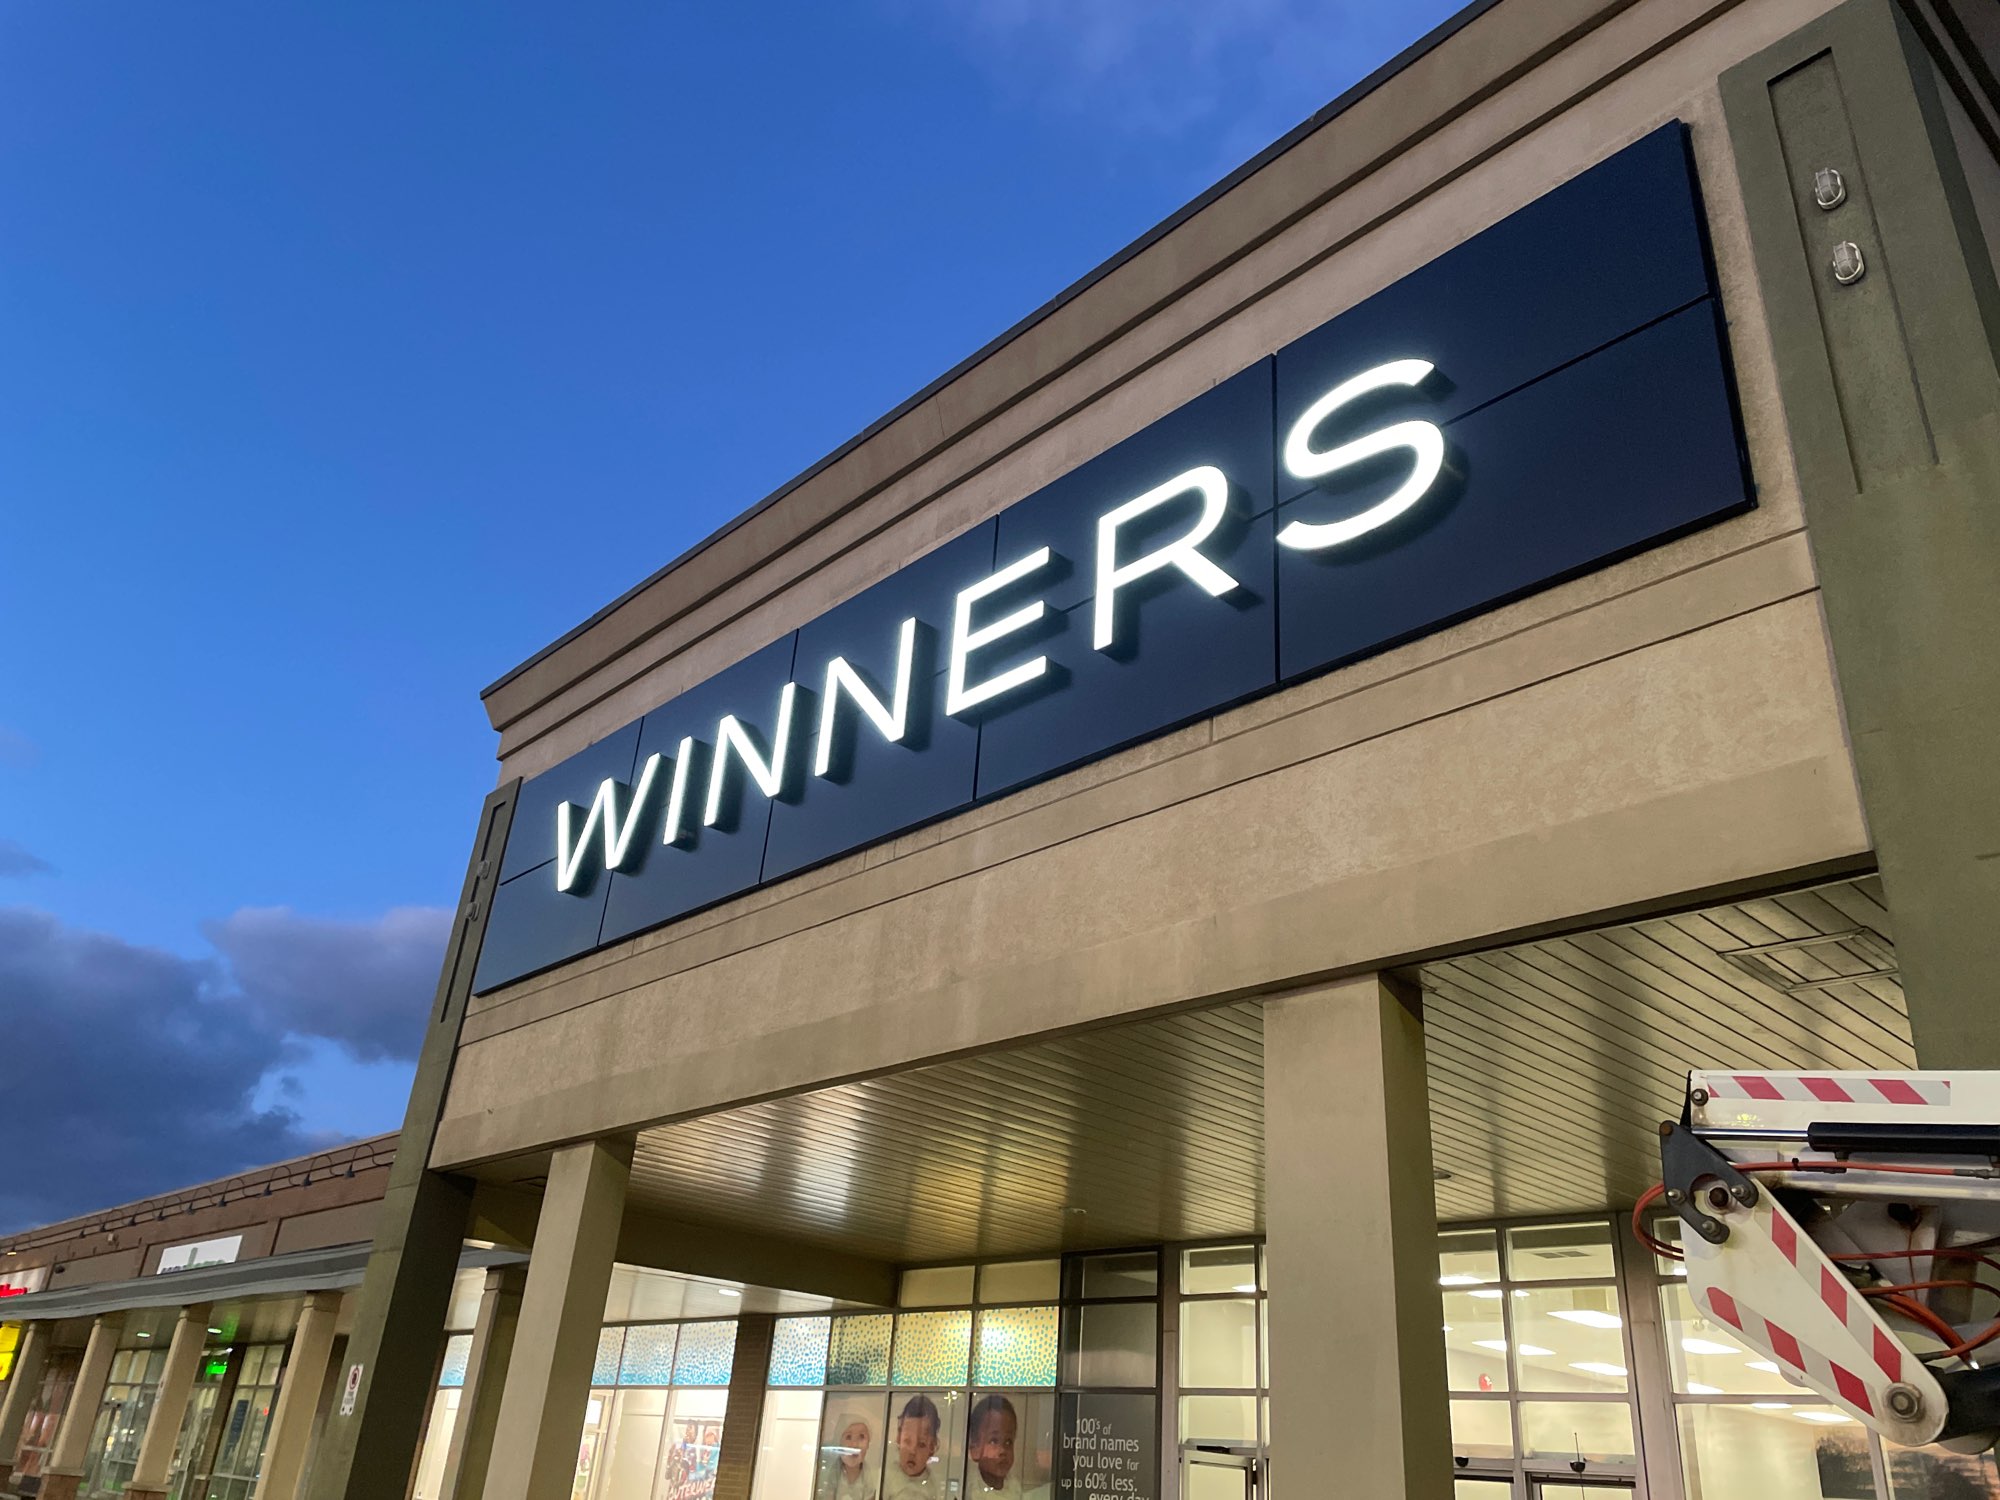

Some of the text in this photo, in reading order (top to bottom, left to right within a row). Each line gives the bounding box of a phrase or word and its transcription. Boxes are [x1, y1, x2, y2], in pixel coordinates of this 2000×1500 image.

[558, 359, 1444, 891] WINNERS
[1103, 1424, 1112, 1435] of
[1063, 1433, 1139, 1452] brand names
[1073, 1452, 1140, 1471] you love for
[1061, 1478, 1071, 1490] up
[1074, 1477, 1082, 1488] to
[1084, 1472, 1107, 1490] 60%
